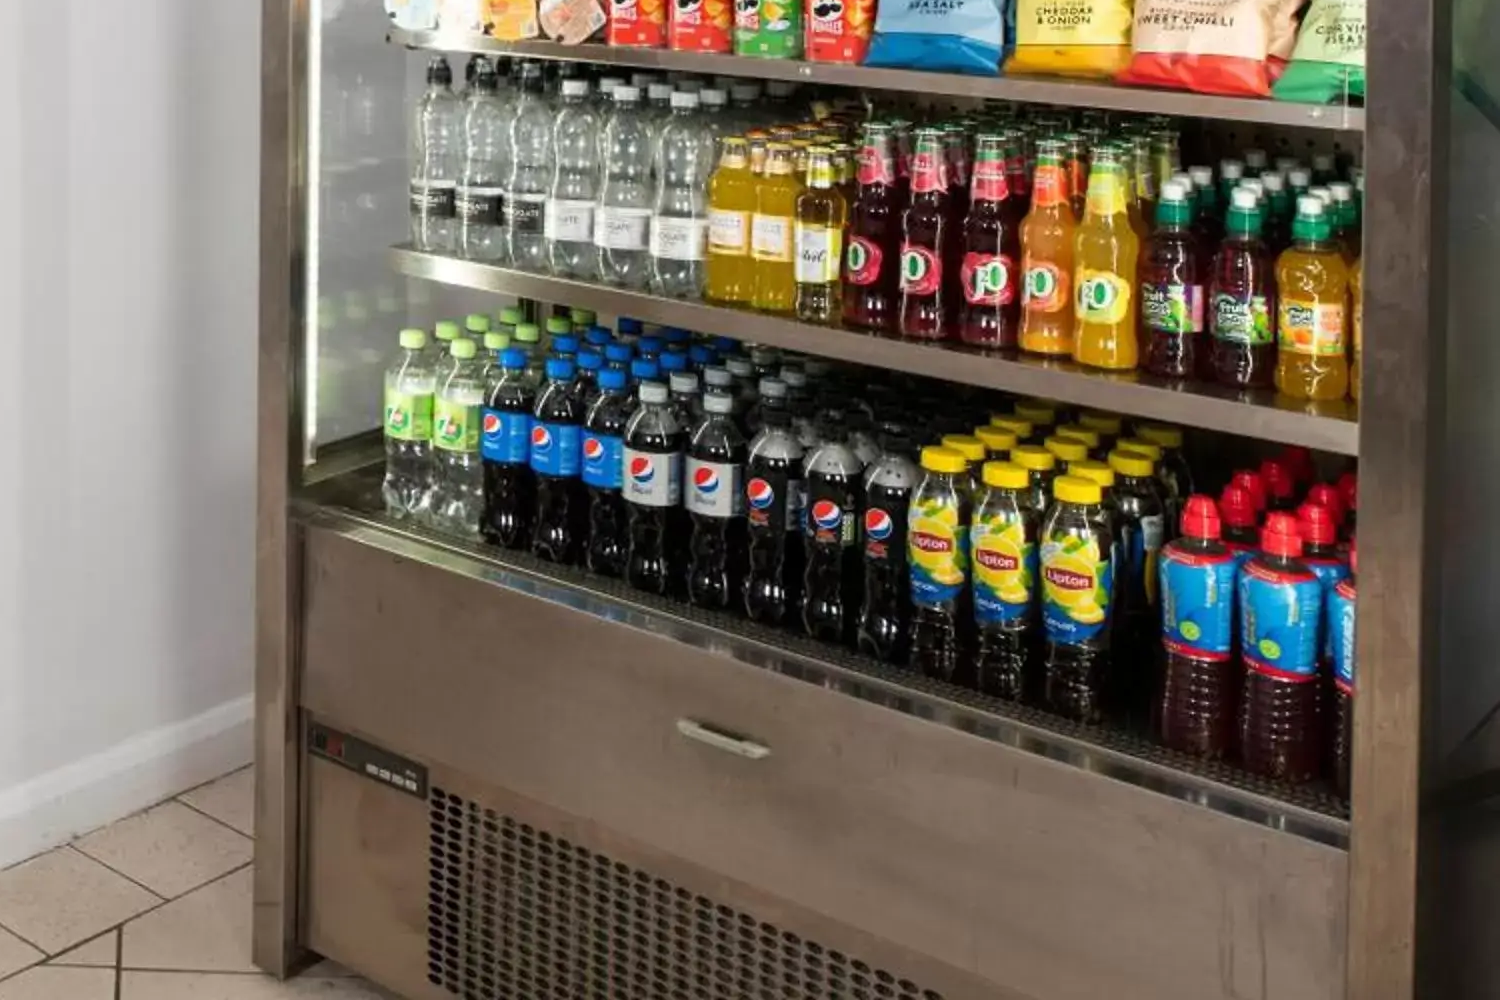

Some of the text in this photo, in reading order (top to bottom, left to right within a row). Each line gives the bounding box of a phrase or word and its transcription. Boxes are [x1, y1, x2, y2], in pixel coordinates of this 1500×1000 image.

[933, 0, 964, 10] SALT
[1035, 7, 1094, 16] CHEDDAR
[1047, 15, 1091, 25] ONION
[1182, 15, 1235, 27] CHILLI
[1219, 302, 1249, 314] Fruit
[912, 532, 949, 551] Lipton
[977, 549, 1015, 569] Lipton
[1047, 568, 1090, 588] Lipton
